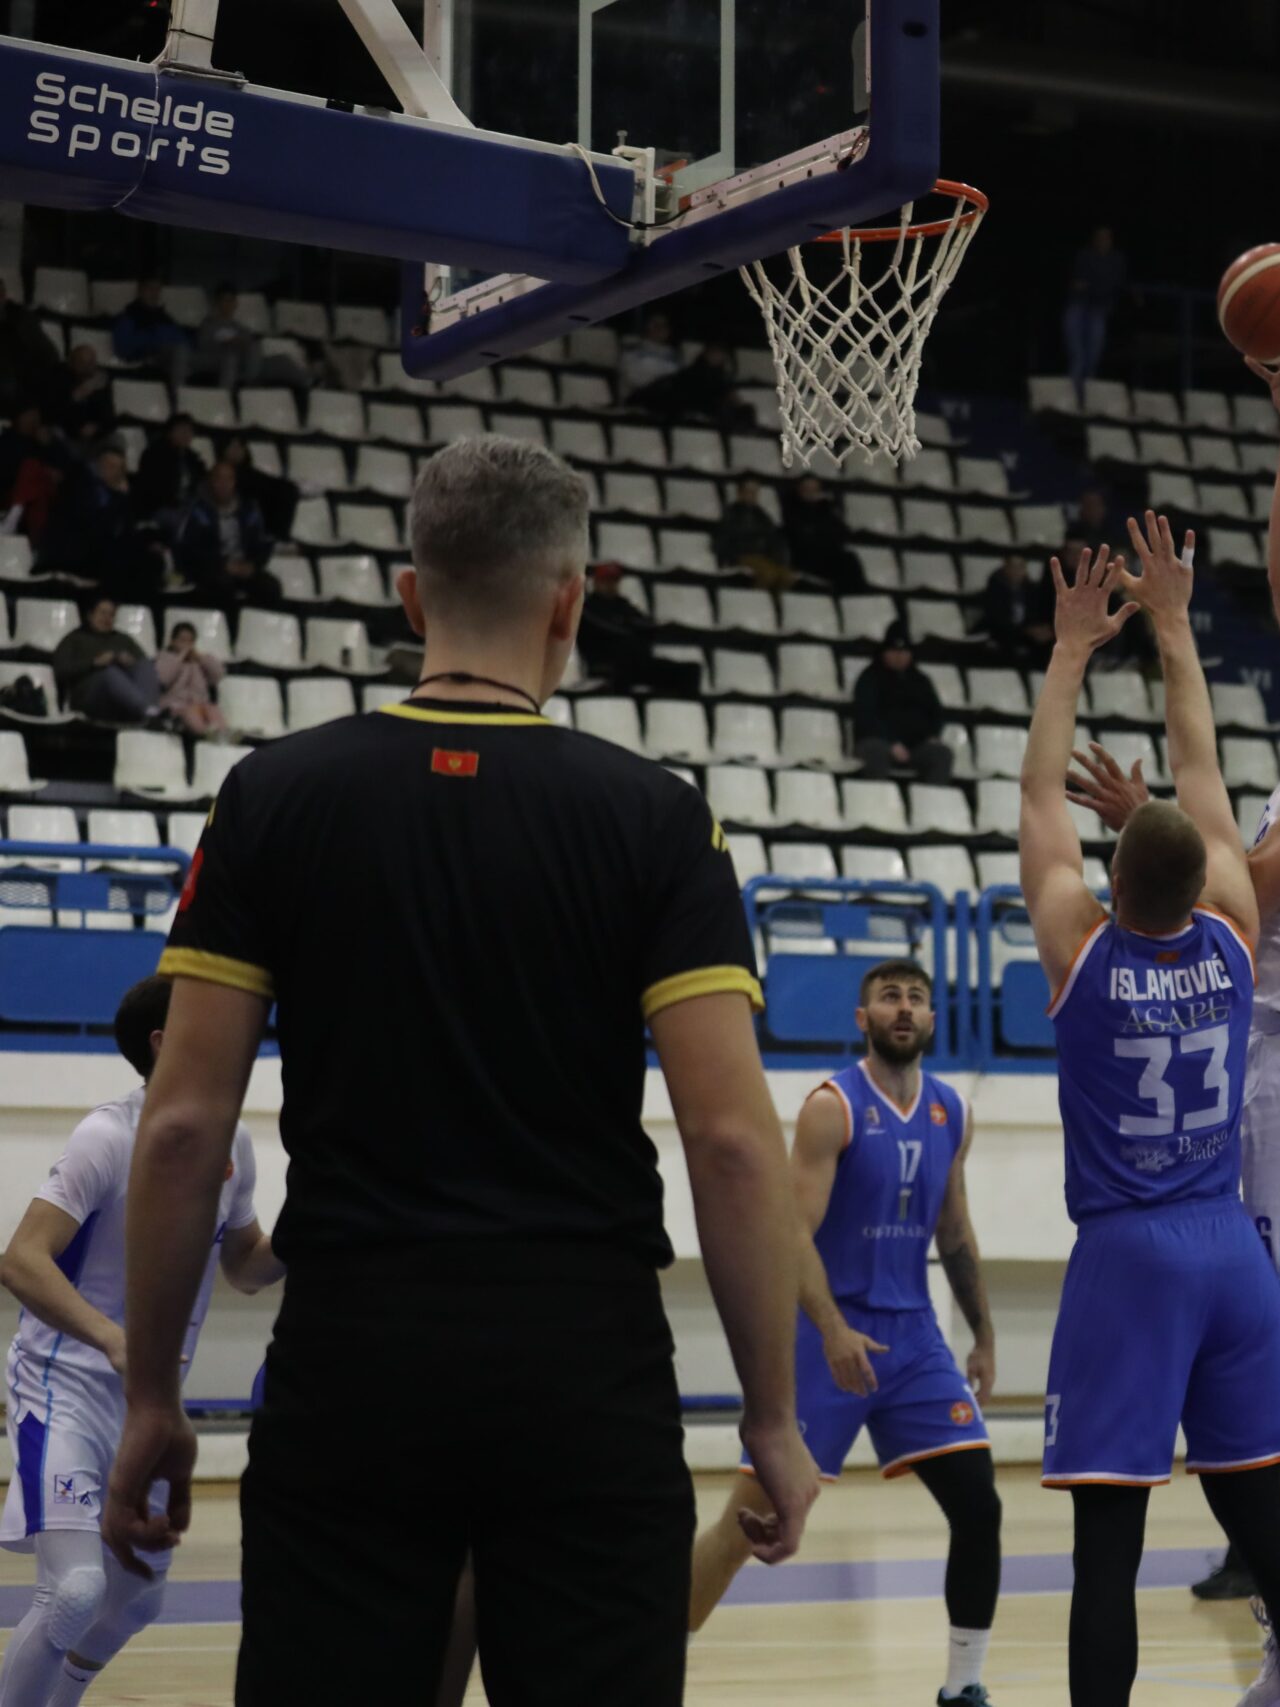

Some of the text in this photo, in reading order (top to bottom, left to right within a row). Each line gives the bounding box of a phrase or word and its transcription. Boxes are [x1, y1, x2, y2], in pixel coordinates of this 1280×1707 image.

[33, 71, 235, 138] Schelde
[27, 109, 230, 175] Sports
[1110, 953, 1232, 1001] ISLAMOVIĆ
[1113, 1023, 1230, 1136] 33
[897, 1139, 923, 1184] 17
